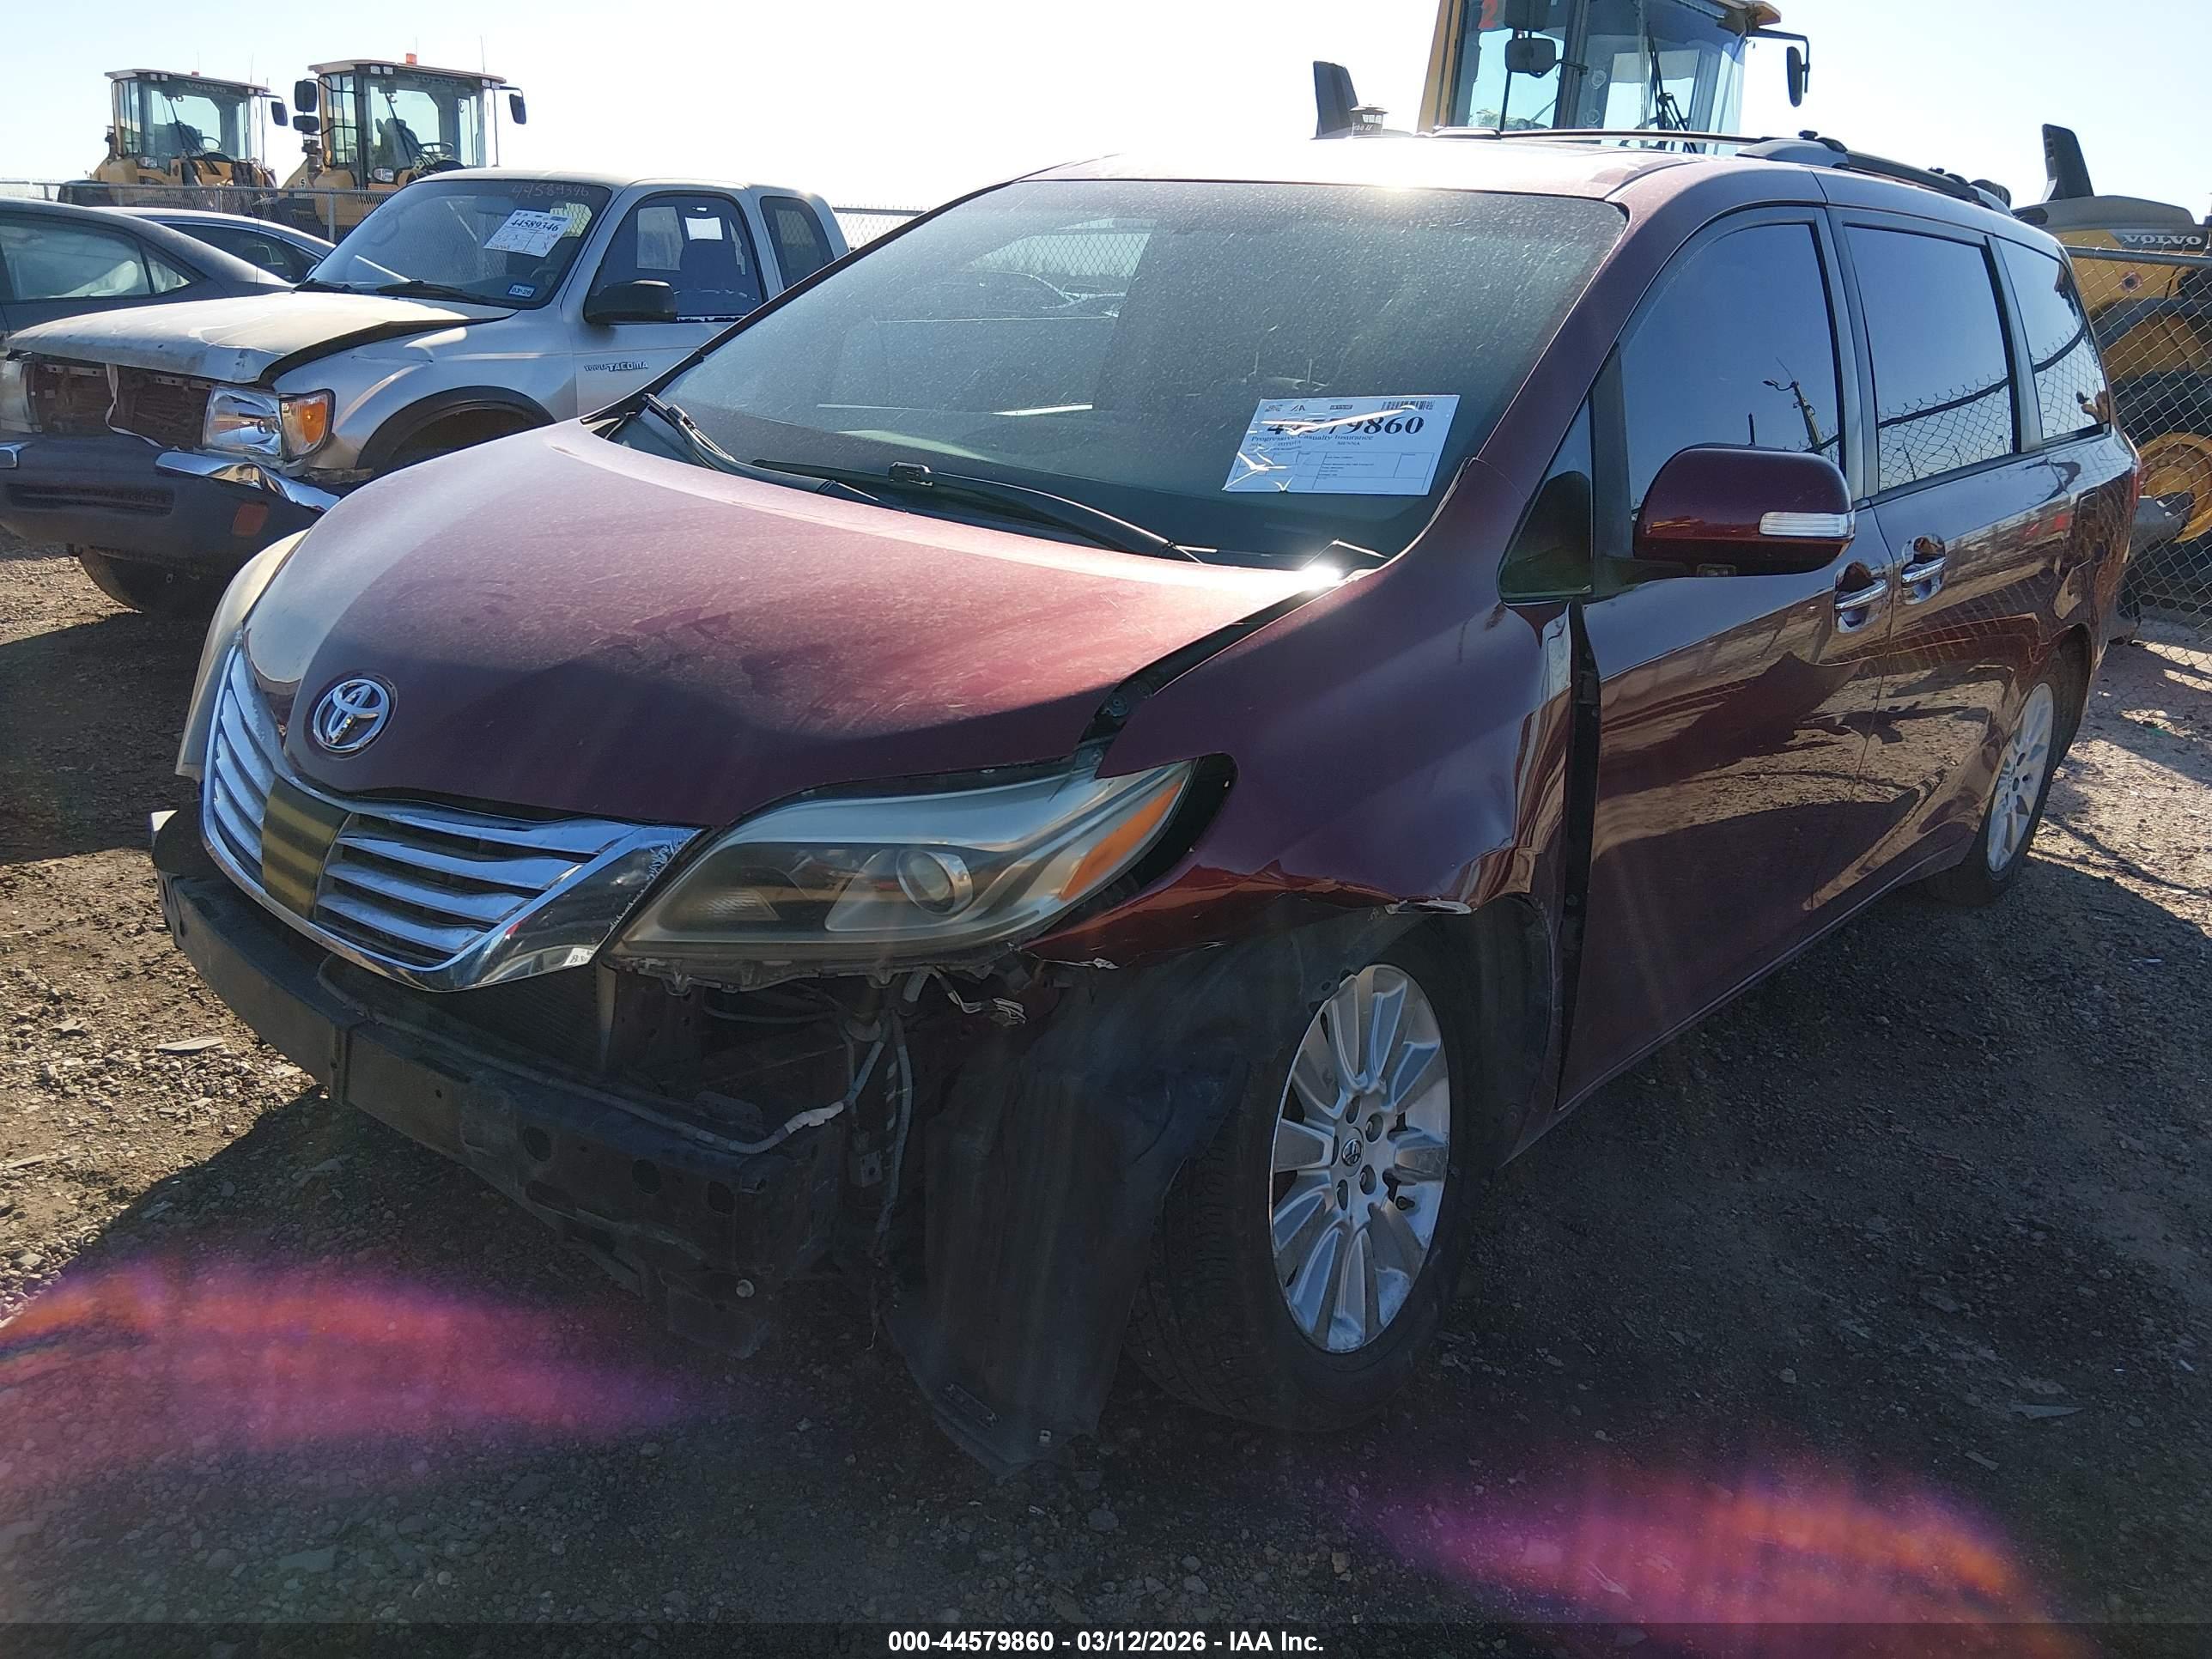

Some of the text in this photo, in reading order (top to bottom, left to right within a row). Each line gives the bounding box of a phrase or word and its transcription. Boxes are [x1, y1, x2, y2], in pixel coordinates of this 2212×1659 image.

[511, 219, 559, 232] 44589346
[2123, 234, 2203, 246] VOLVO
[607, 361, 648, 372] TACOMA
[1267, 416, 1425, 434] 4579860
